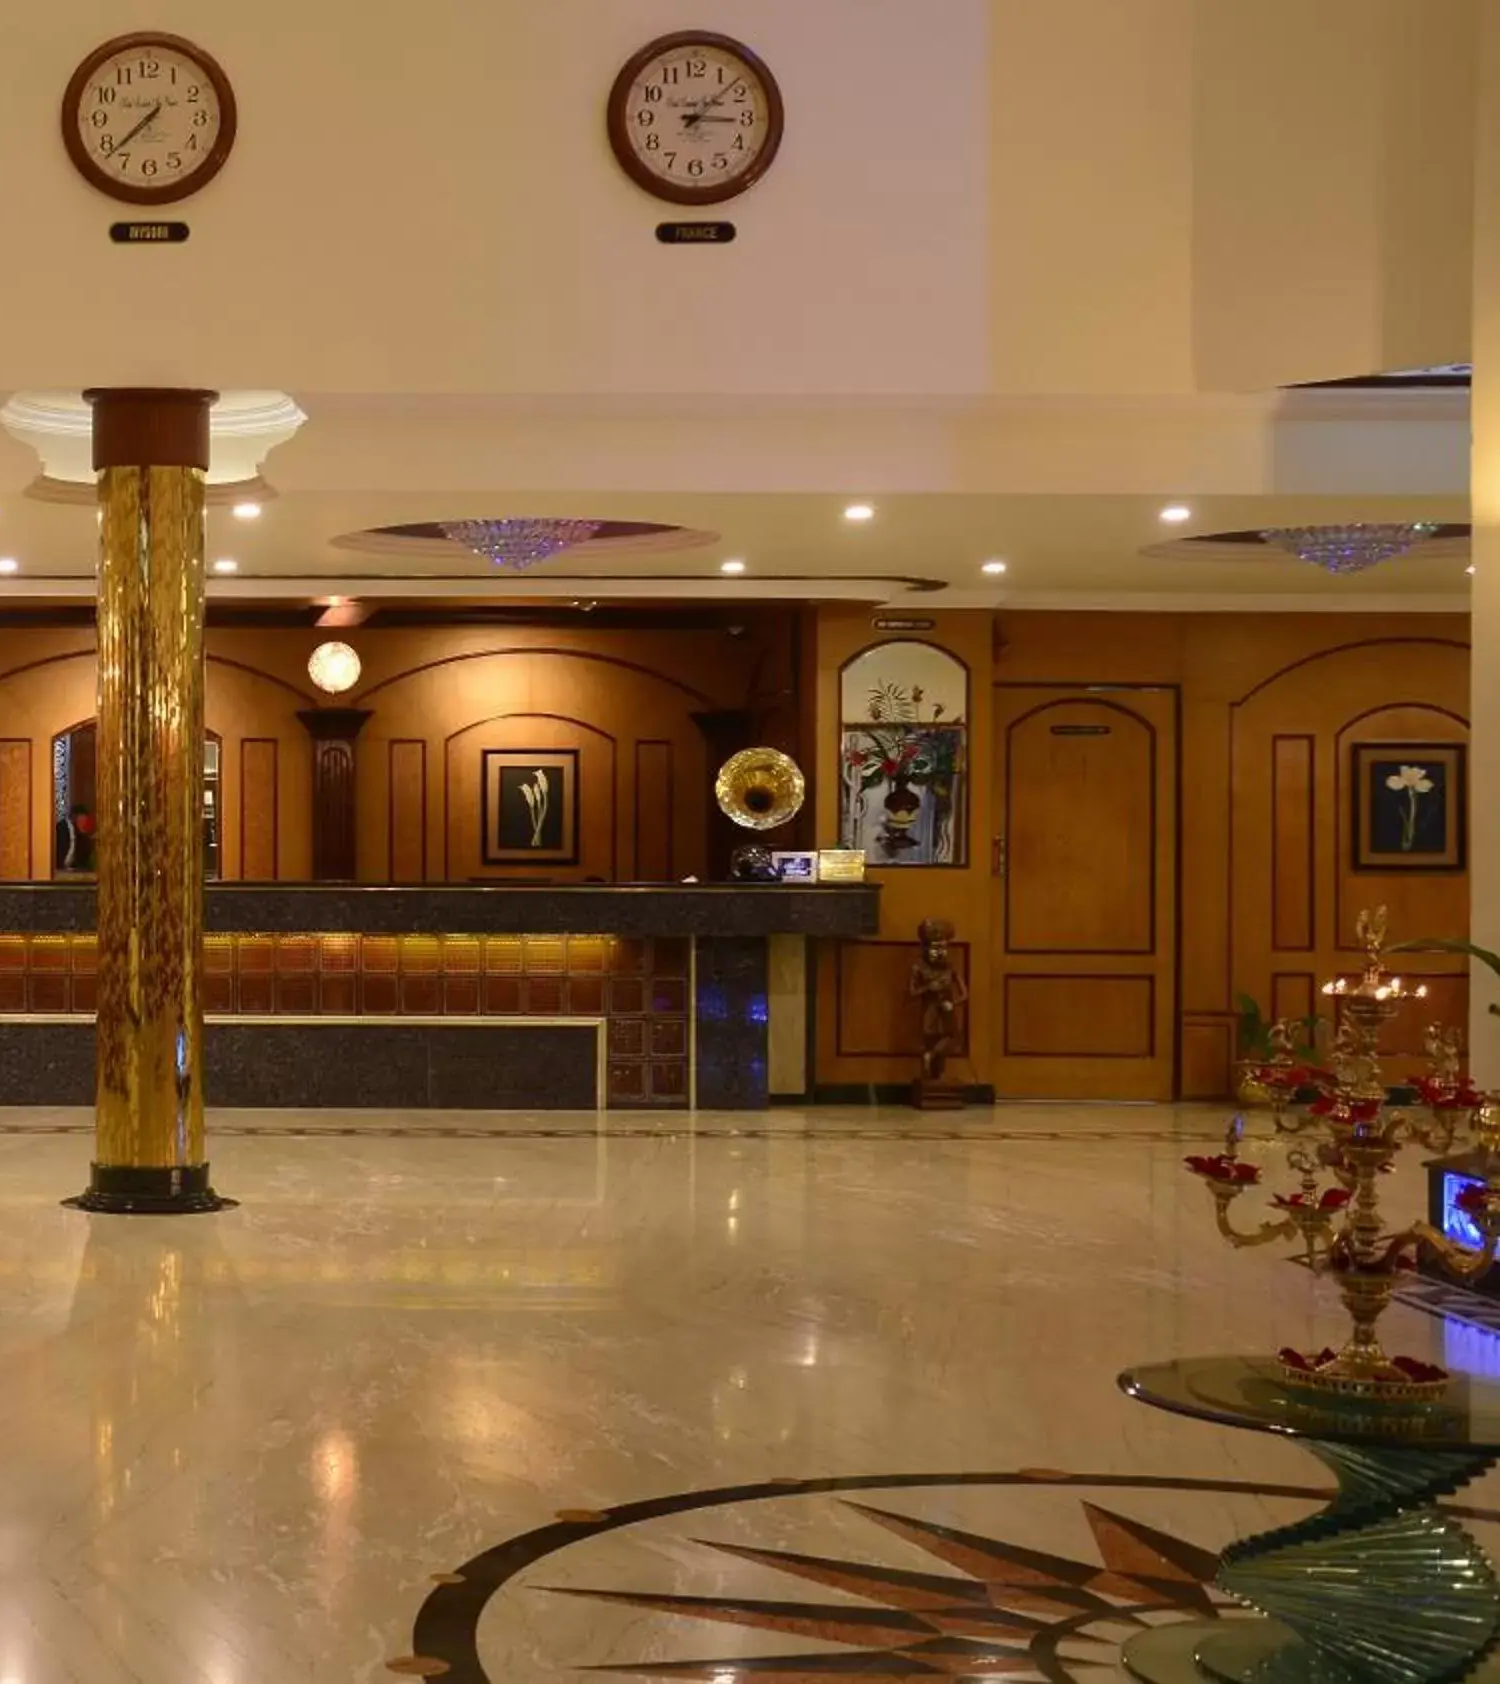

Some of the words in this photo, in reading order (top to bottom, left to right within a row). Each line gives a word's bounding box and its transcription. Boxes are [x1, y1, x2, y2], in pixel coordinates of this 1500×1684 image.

[117, 68, 132, 84] 11
[138, 62, 159, 78] 12
[170, 68, 176, 84] 1
[663, 67, 678, 84] 11
[686, 61, 706, 77] 12
[717, 68, 723, 84] 1
[98, 88, 115, 103] 10
[187, 86, 199, 102] 2
[644, 87, 662, 102] 10
[733, 87, 746, 102] 2
[92, 110, 107, 127] 9
[193, 111, 207, 126] 3
[638, 110, 653, 126] 9
[741, 111, 753, 126] 3
[100, 135, 114, 152] 8
[185, 134, 196, 150] 4
[646, 134, 659, 150] 8
[732, 134, 743, 150] 4
[118, 154, 130, 169] 7
[142, 160, 157, 175] 6
[167, 153, 181, 168] 5
[664, 153, 677, 169] 7
[688, 160, 703, 176] 6
[711, 154, 727, 169] 5
